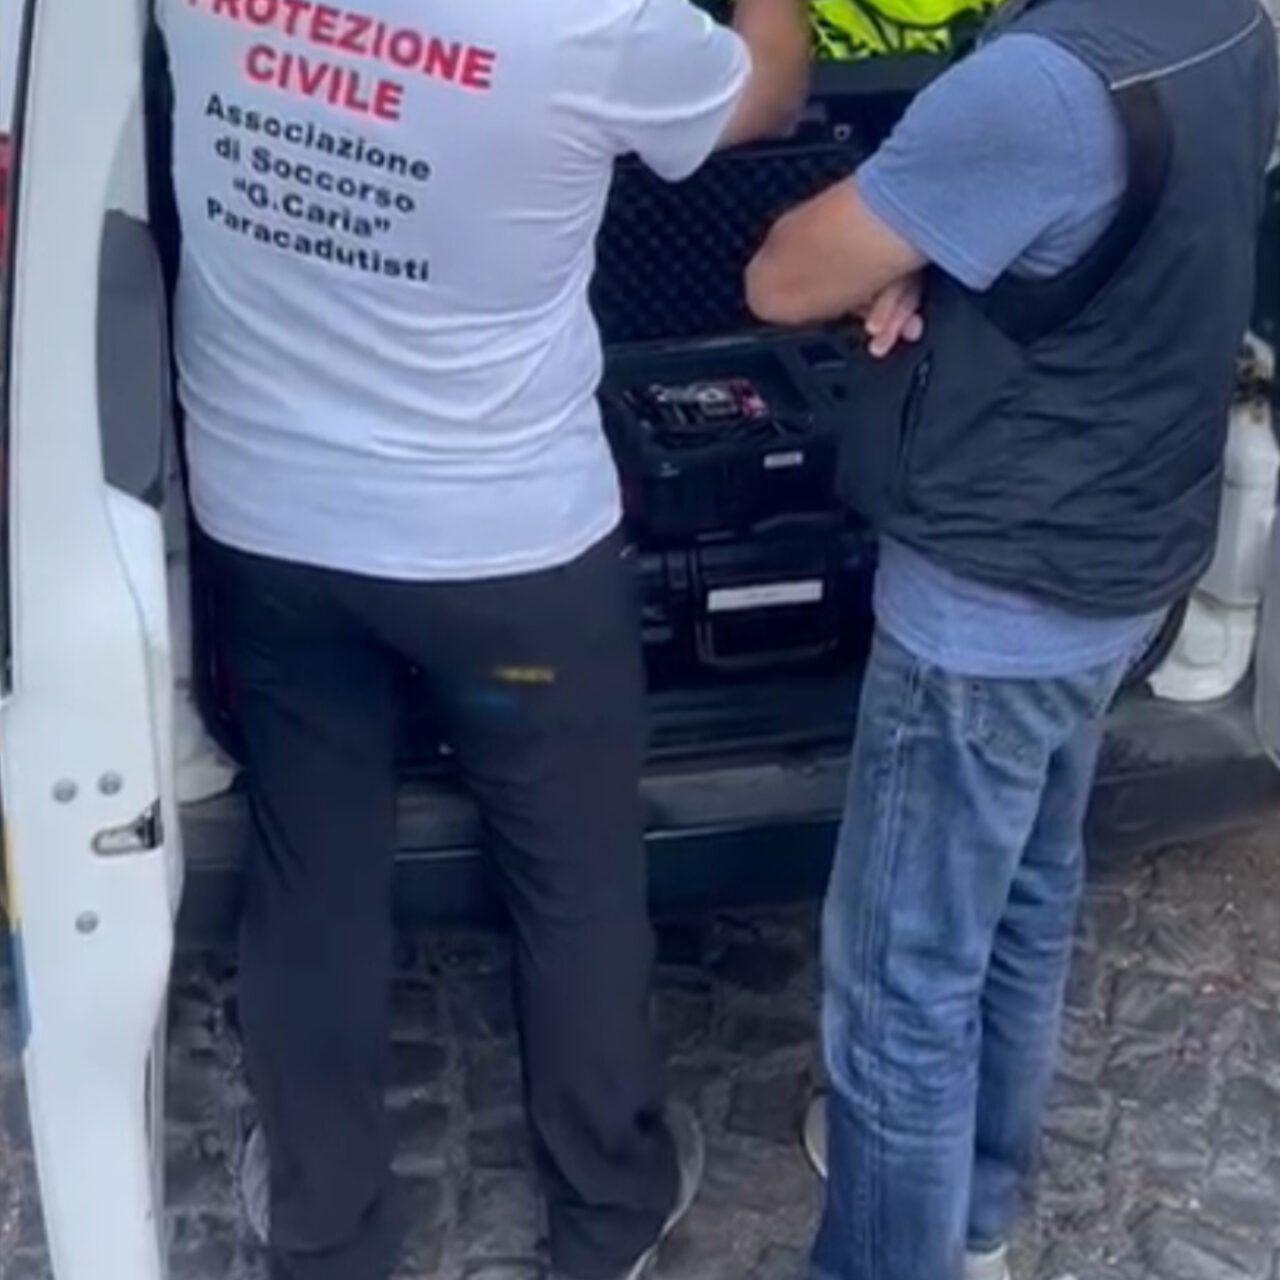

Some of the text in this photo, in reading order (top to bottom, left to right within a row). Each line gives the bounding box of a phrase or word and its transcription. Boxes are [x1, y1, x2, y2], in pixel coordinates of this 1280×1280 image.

[245, 44, 404, 121] CIVILE
[205, 94, 431, 181] Associazione
[215, 137, 415, 214] di Soccorso
[206, 196, 429, 282] Paracadutisti
